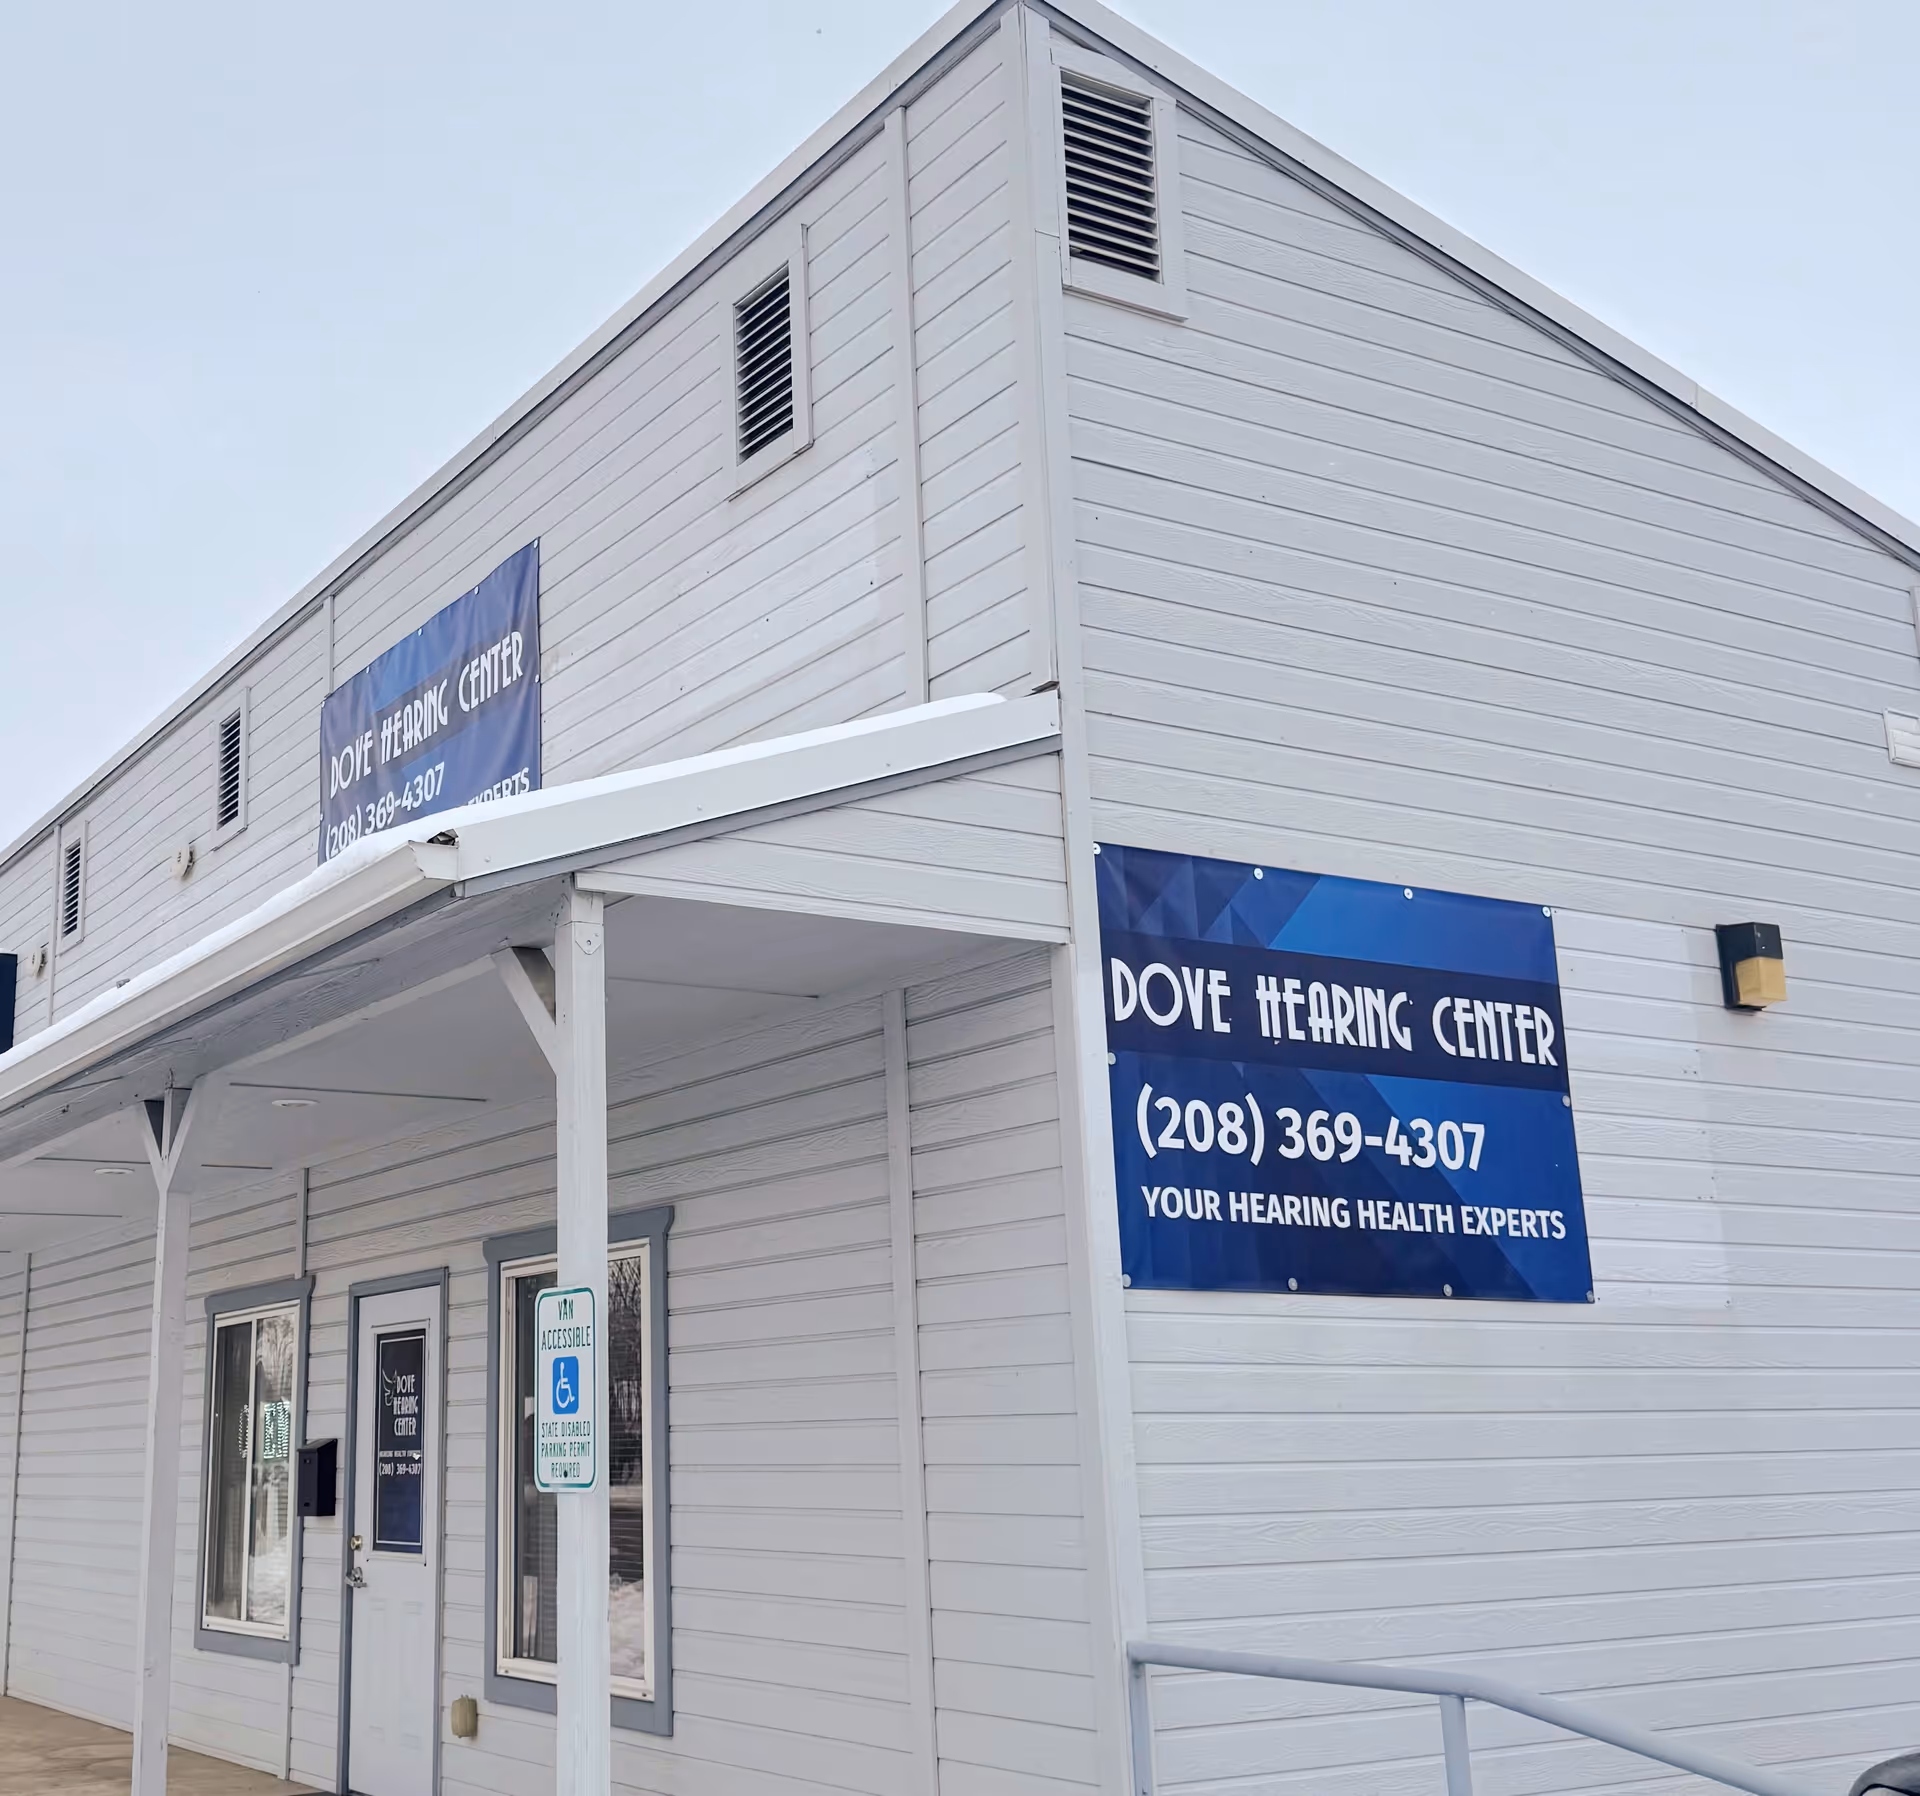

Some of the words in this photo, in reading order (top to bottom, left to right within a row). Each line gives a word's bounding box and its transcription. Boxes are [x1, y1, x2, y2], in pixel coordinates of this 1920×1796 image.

[330, 730, 372, 799] DOVE
[380, 679, 447, 764] HEARING
[458, 631, 523, 713] CENTER
[468, 767, 530, 805] ERTS
[325, 804, 361, 861] (208)
[365, 761, 445, 835] 369-4307
[1110, 957, 1231, 1034] DOVE
[1256, 975, 1413, 1051] HEARING
[1432, 996, 1558, 1067] CENTER
[1137, 1083, 1265, 1166] (208)
[1276, 1107, 1485, 1171] 369-4307
[1141, 1186, 1222, 1221] YOUR
[1229, 1191, 1350, 1229] HEARING
[1358, 1199, 1455, 1234] HEALTH
[1462, 1206, 1566, 1240] EXPERTS
[558, 1298, 573, 1320] VAN
[541, 1325, 591, 1350] ACCESSIBLE
[397, 1374, 415, 1393] DOVE
[393, 1395, 418, 1415] HEARING
[394, 1416, 416, 1436] CENTER
[541, 1422, 558, 1438] STATE
[561, 1420, 590, 1437] DISABLED
[541, 1442, 567, 1457] PARKING
[569, 1441, 590, 1457] PERMIT
